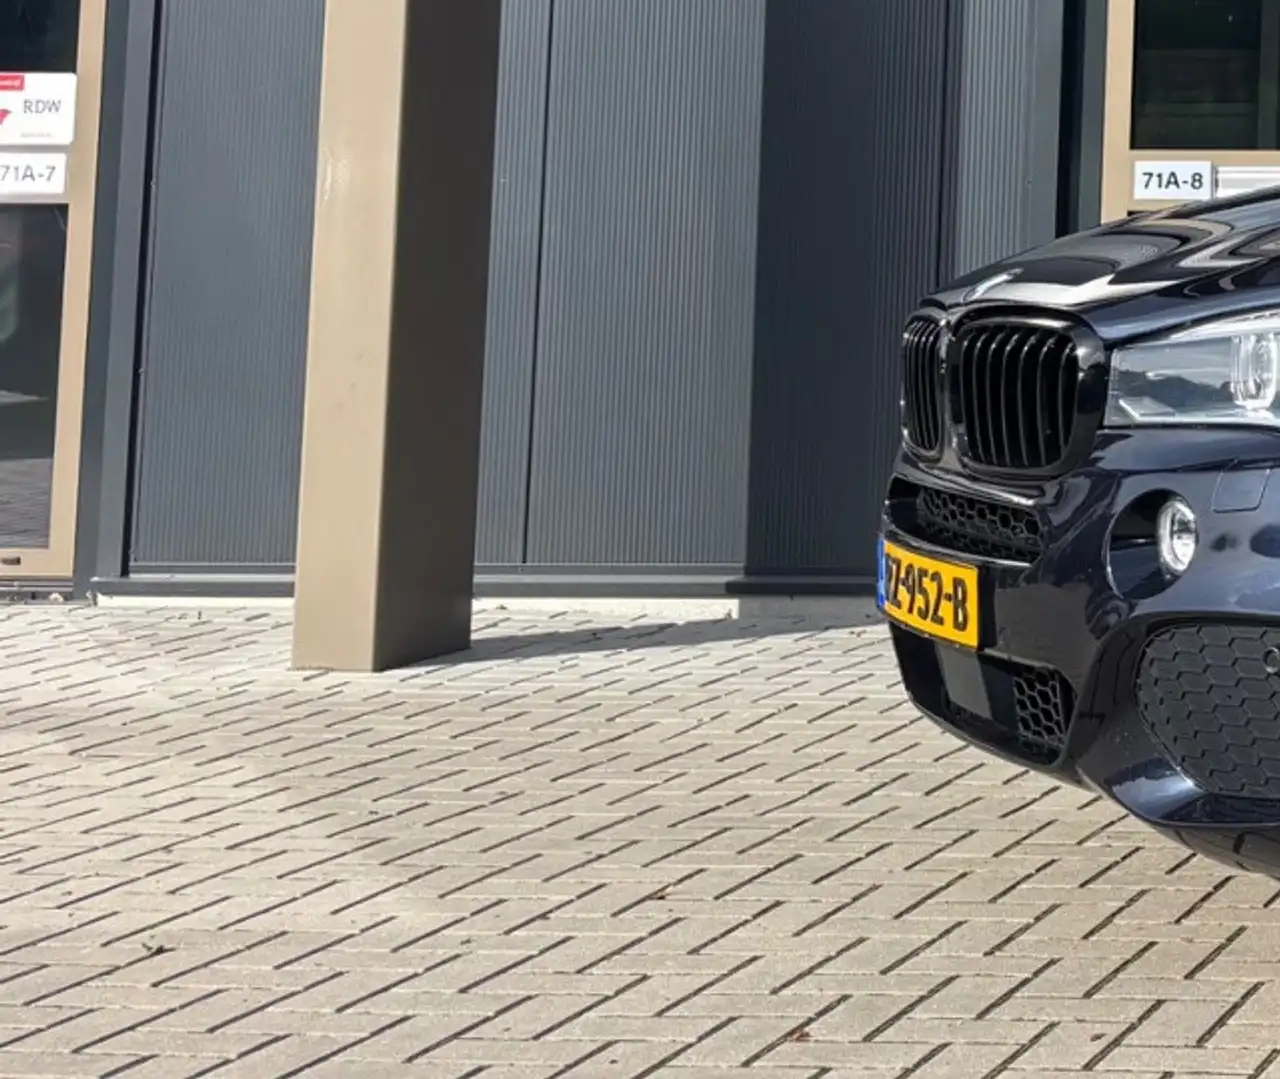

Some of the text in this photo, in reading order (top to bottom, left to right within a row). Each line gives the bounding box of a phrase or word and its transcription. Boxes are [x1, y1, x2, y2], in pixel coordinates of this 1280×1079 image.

[22, 98, 62, 115] RDW
[0, 164, 57, 183] 71A-7
[1141, 171, 1204, 190] 71A-8
